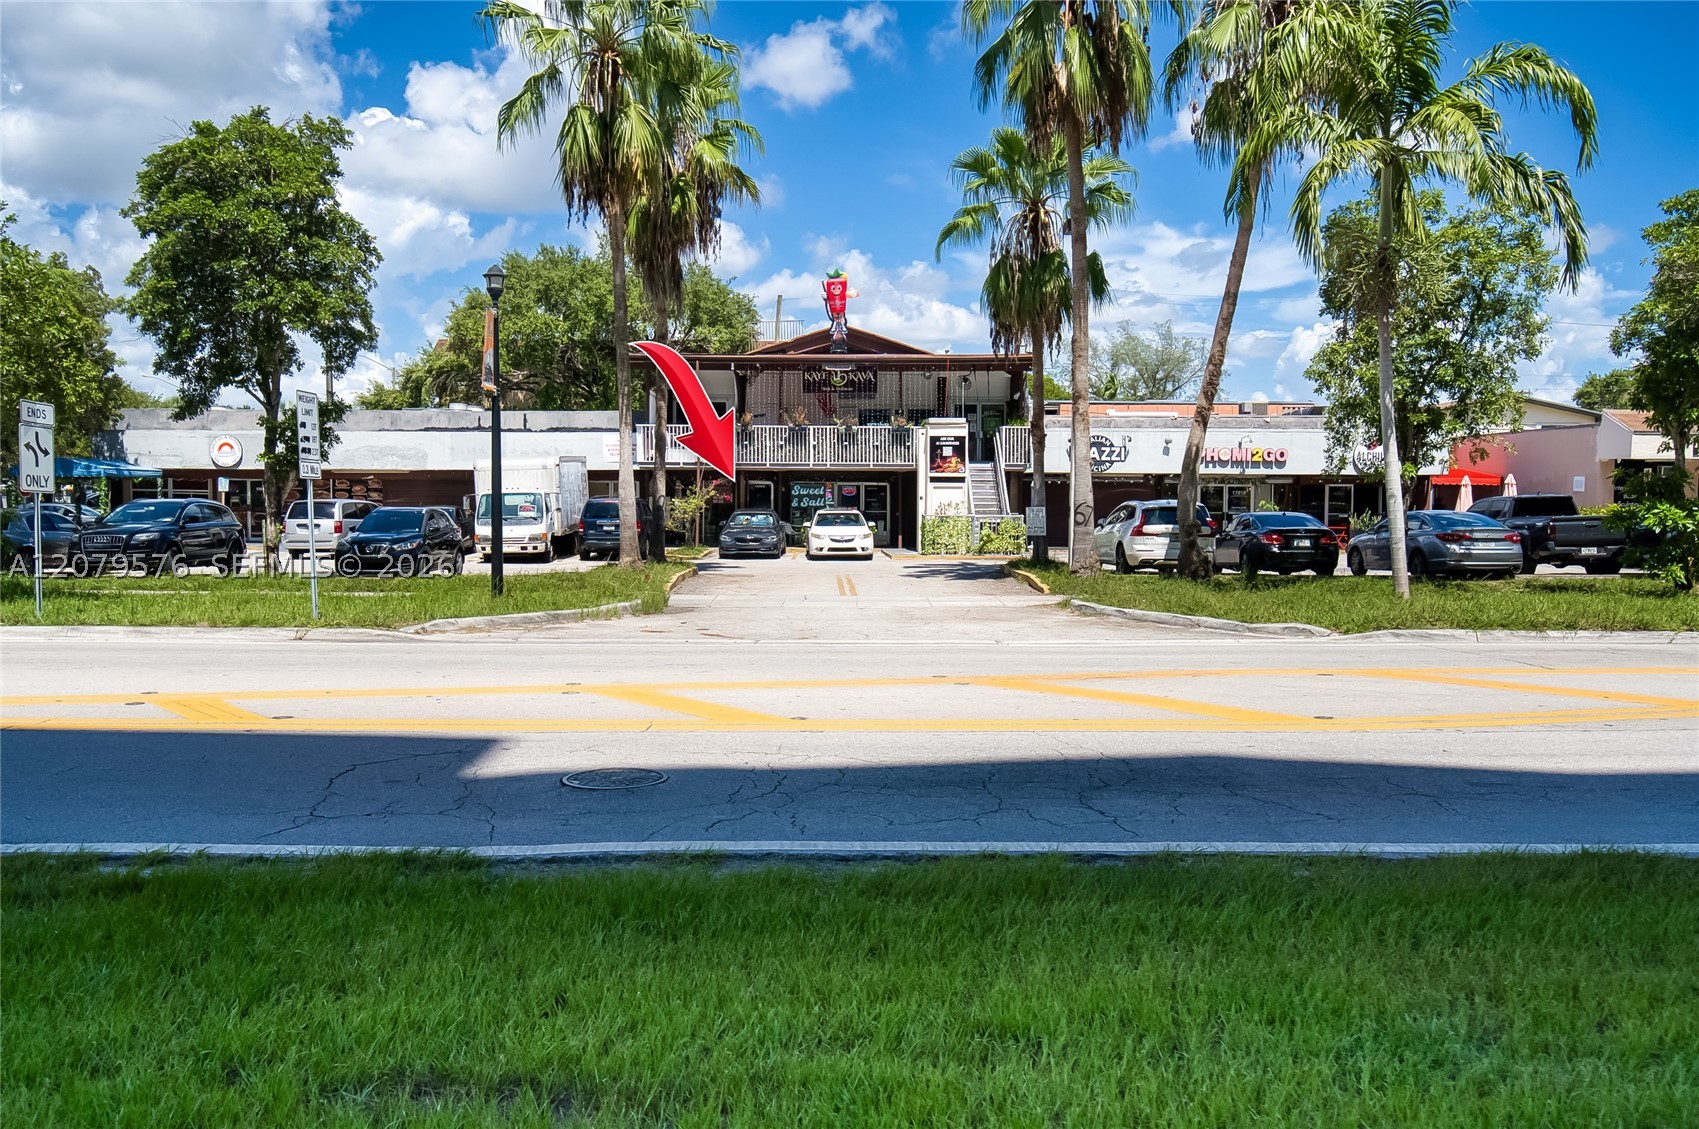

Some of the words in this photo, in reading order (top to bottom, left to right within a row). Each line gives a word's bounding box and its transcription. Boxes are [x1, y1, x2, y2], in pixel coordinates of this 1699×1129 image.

[848, 370, 876, 382] KAVA
[299, 394, 316, 405] WEIGHT
[26, 406, 47, 420] ENDS
[301, 407, 314, 417] LIMIT
[1090, 446, 1126, 461] AZZI
[25, 474, 50, 488] ONLY
[791, 485, 825, 496] Sweet
[791, 498, 799, 507] &
[800, 497, 825, 507] Salt
[1074, 501, 1094, 527] 67
